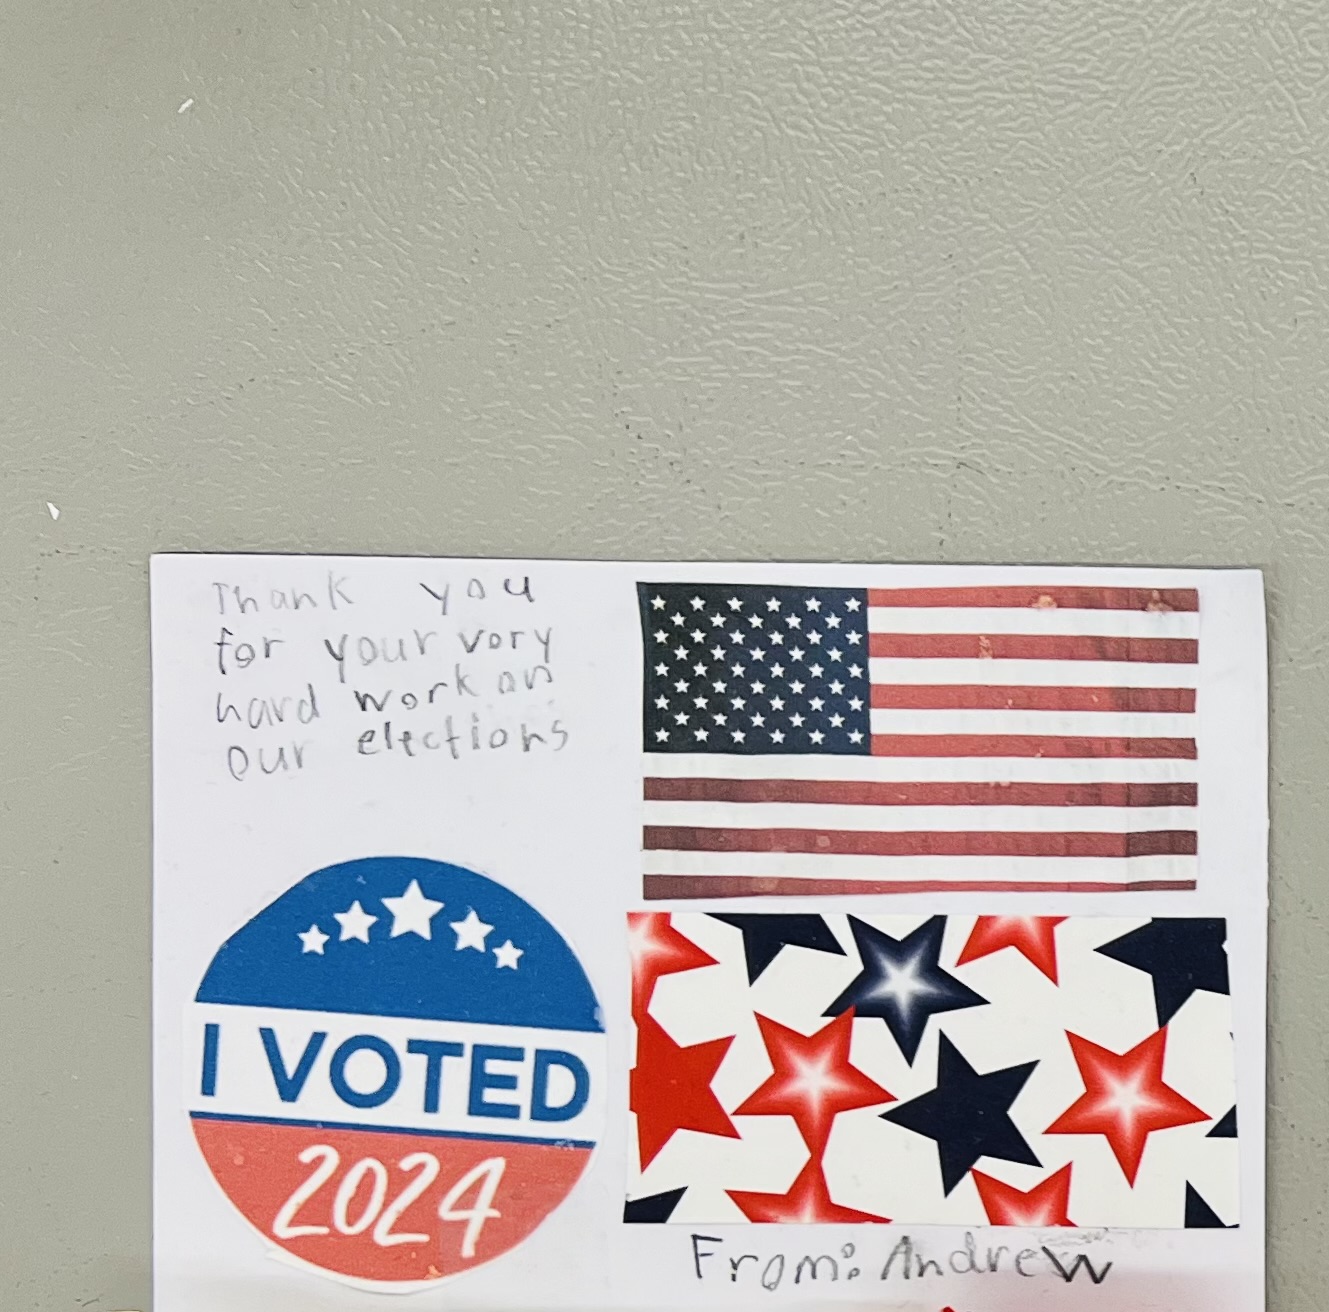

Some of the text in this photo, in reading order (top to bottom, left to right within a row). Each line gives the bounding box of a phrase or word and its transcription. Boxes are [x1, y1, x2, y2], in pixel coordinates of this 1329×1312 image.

[213, 572, 535, 616] Thank you
[214, 627, 285, 674] for
[325, 628, 439, 682] your
[217, 664, 553, 729] hard work on
[228, 715, 569, 780] our elections
[201, 1024, 590, 1122] I VOTED
[273, 1145, 507, 1258] 2024
[692, 1234, 1112, 1291] From: Andrew
